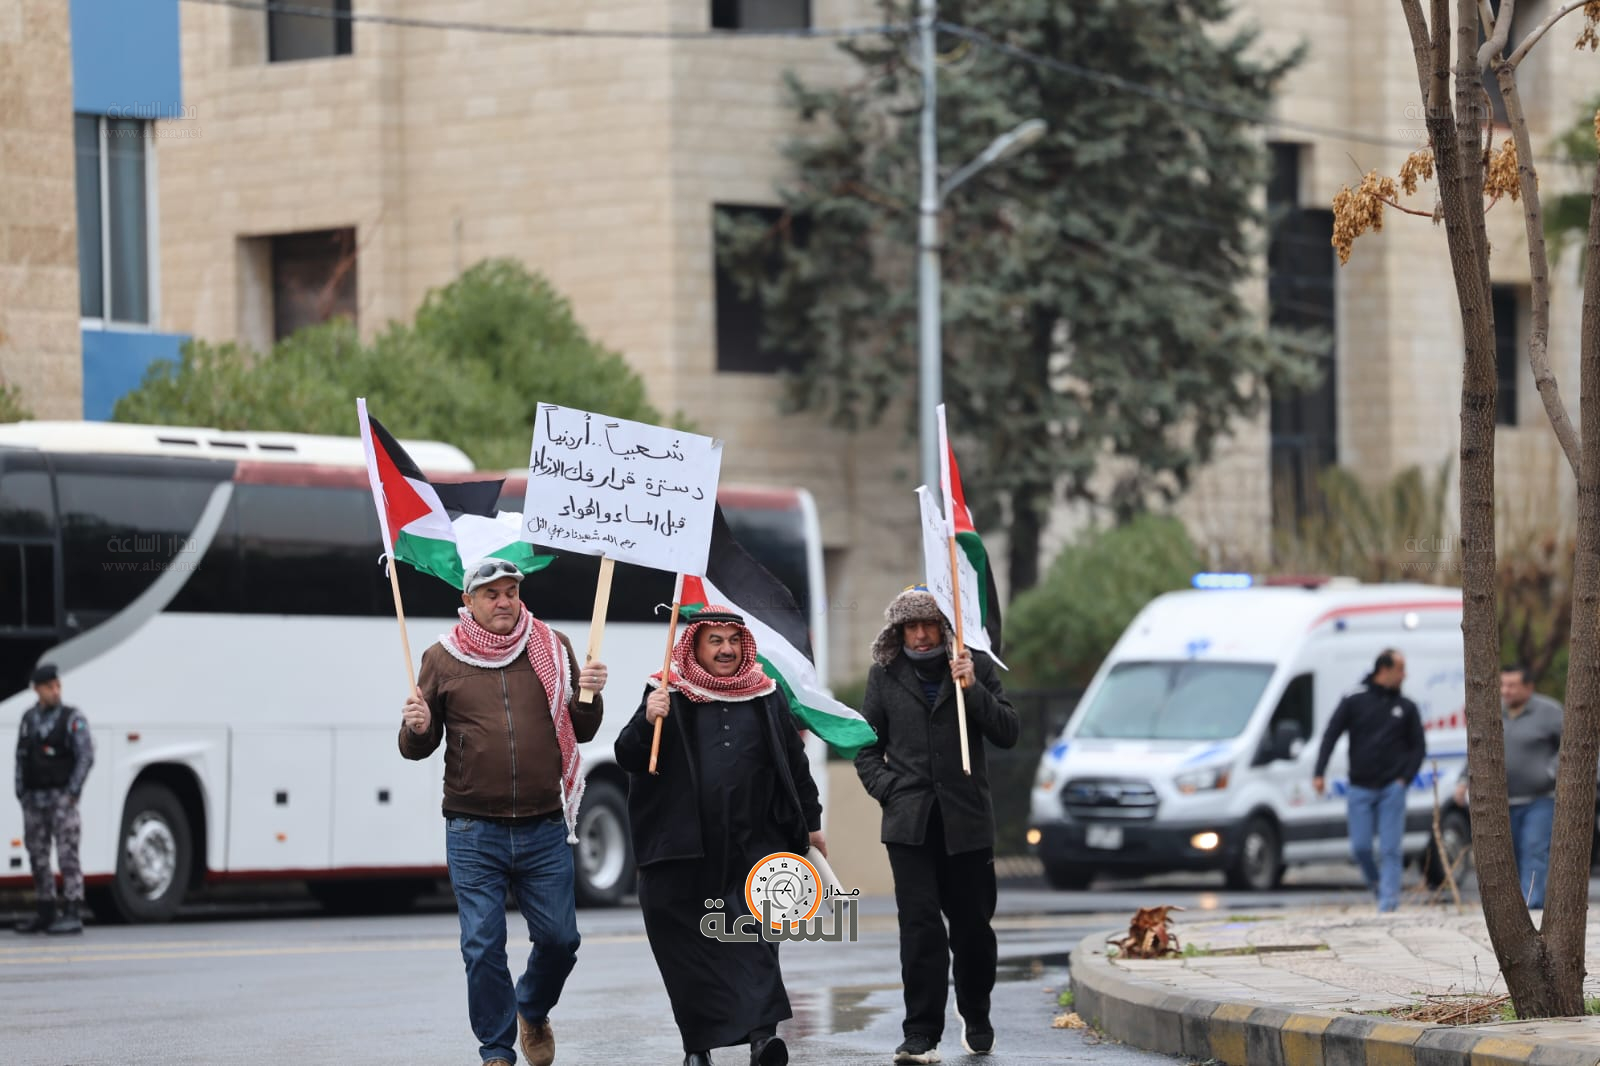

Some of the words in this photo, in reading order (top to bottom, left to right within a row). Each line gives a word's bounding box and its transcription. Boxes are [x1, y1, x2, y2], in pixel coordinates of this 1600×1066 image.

[563, 460, 595, 483] فك
[586, 466, 637, 491] قرار
[612, 503, 660, 532] الماء
[659, 509, 687, 537] قبل
[601, 533, 618, 547] الله
